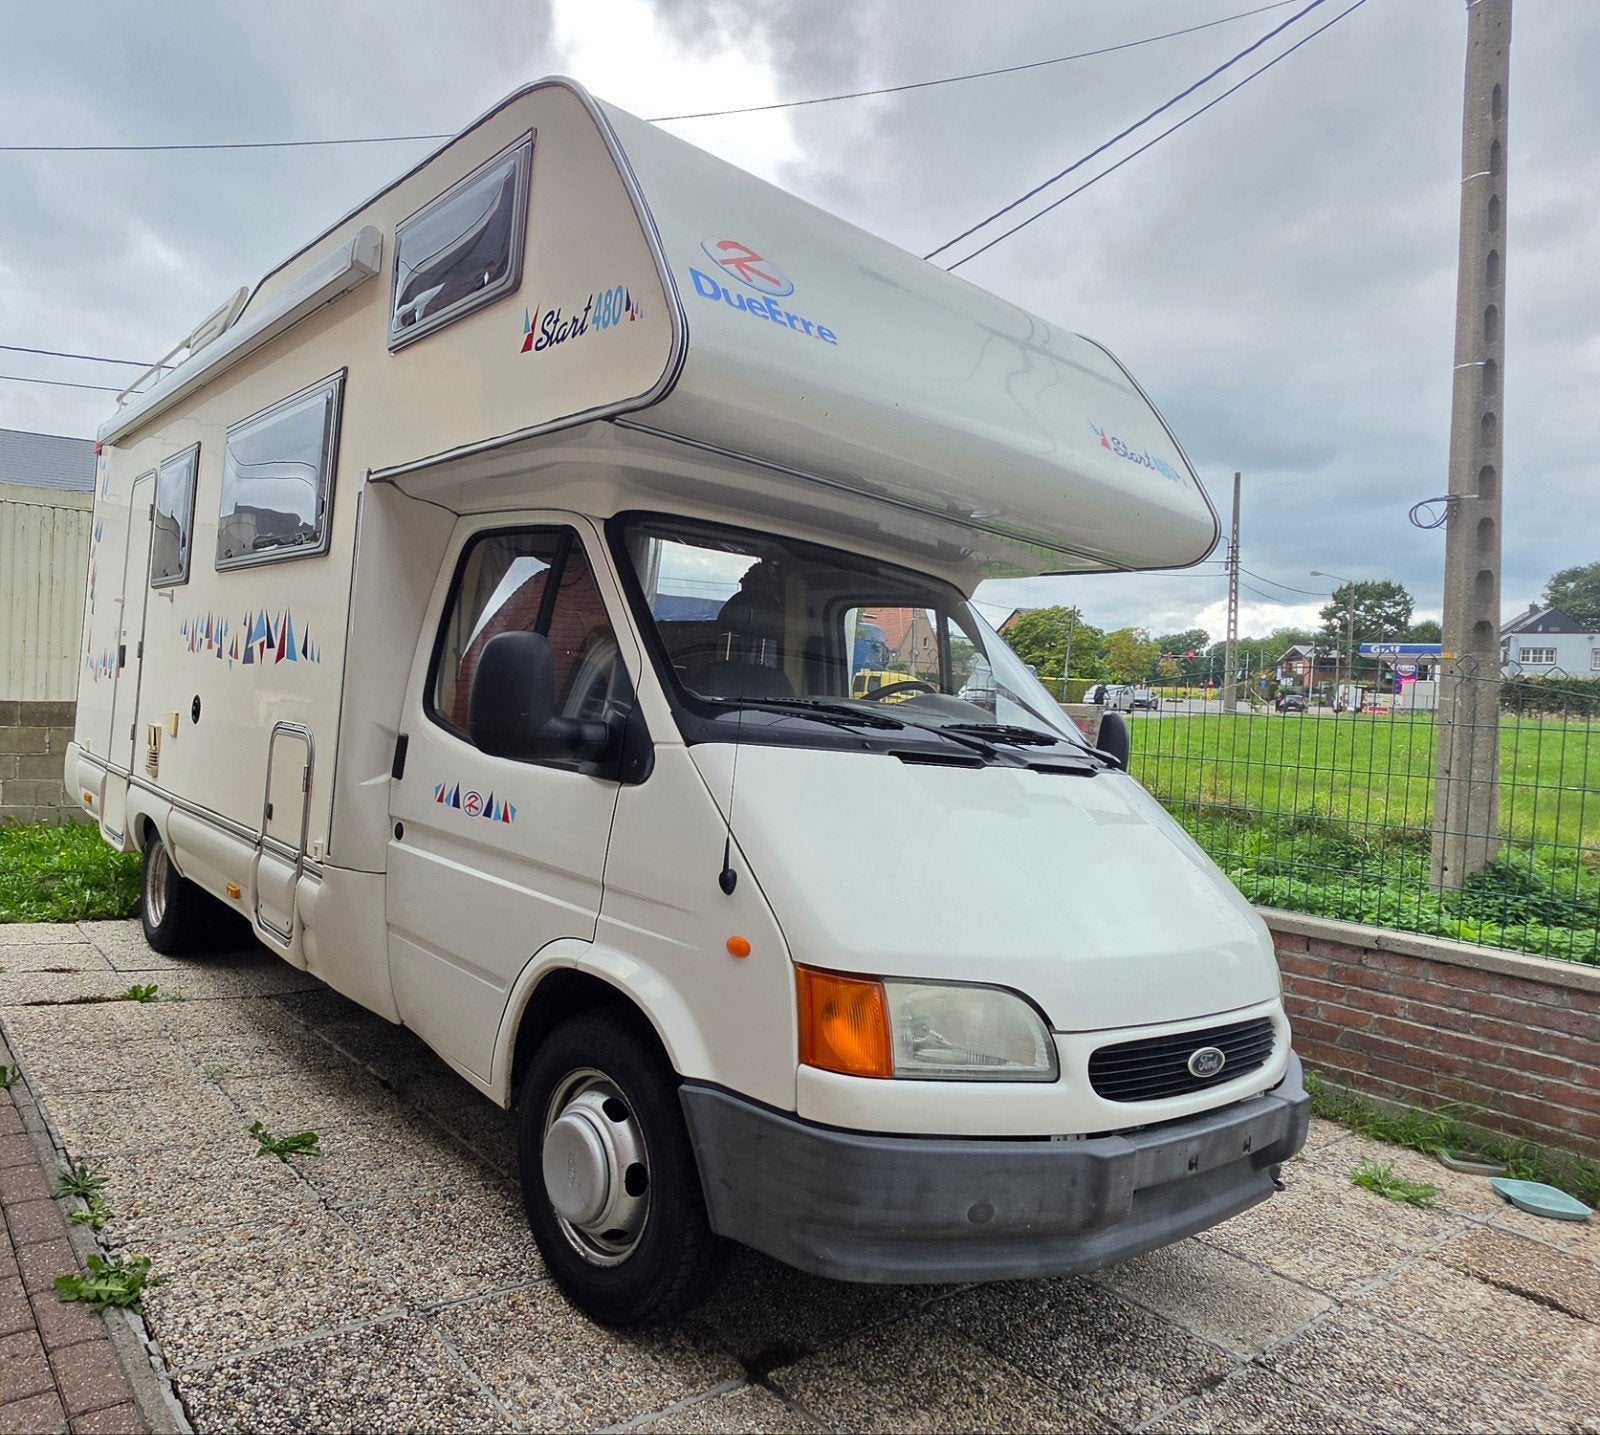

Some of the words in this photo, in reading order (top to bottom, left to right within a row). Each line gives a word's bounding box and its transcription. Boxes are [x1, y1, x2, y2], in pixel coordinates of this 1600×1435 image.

[535, 293, 593, 352] Start
[592, 285, 624, 332] 480
[689, 267, 838, 346] DueErre
